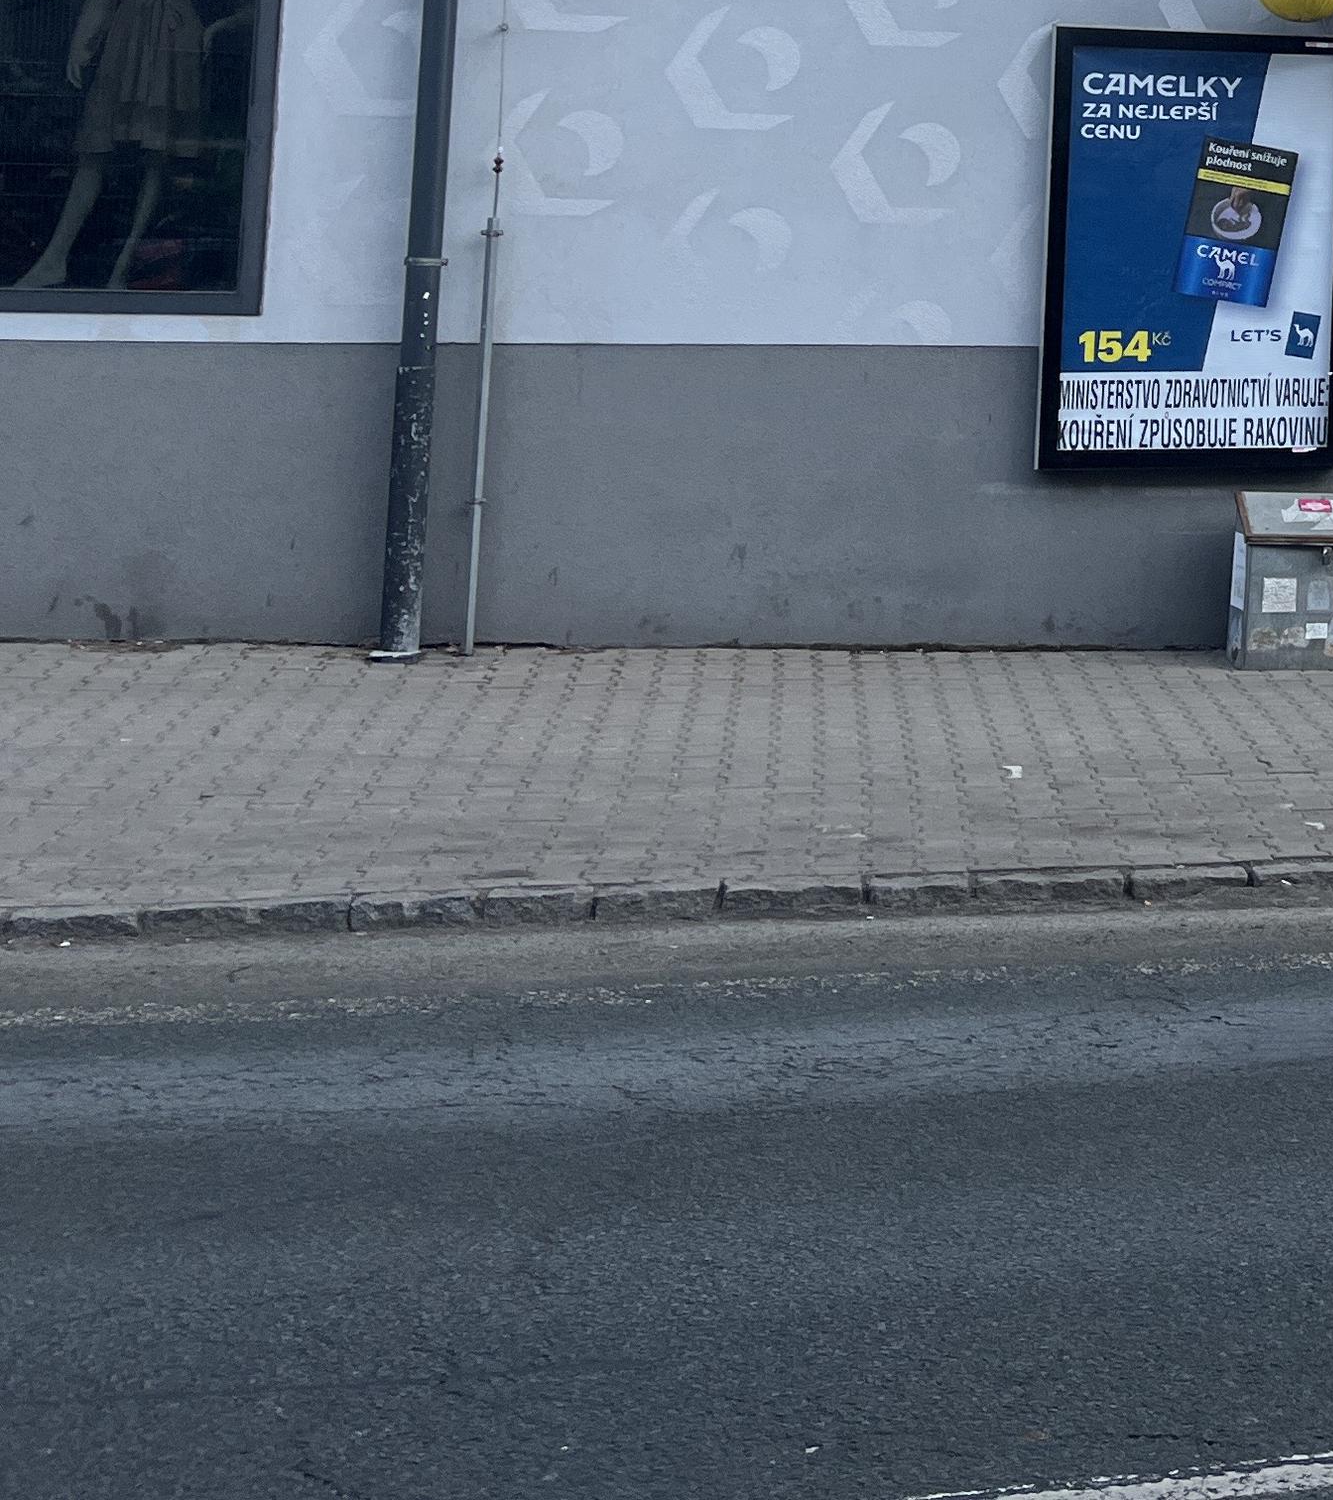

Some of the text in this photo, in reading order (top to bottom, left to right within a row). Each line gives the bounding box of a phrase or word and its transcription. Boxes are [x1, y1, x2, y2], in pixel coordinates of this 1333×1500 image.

[1082, 72, 1243, 99] CAMELKY
[1082, 101, 1219, 121] ZA NEJLEPŠÍ
[1080, 123, 1141, 140] CENU
[1208, 141, 1250, 159] Kouření
[1205, 156, 1252, 172] plodnost
[1196, 244, 1260, 267] CAMEL
[1230, 328, 1282, 343] LET'S
[1078, 330, 1172, 363] 154 Kč
[1060, 372, 1329, 410] MINISTERSTVO ZDRAVOTNICTVÍ VARUJE:
[1057, 412, 1328, 450] KOUŘENÍ ZPŮSOBUJE RAKOVINU
